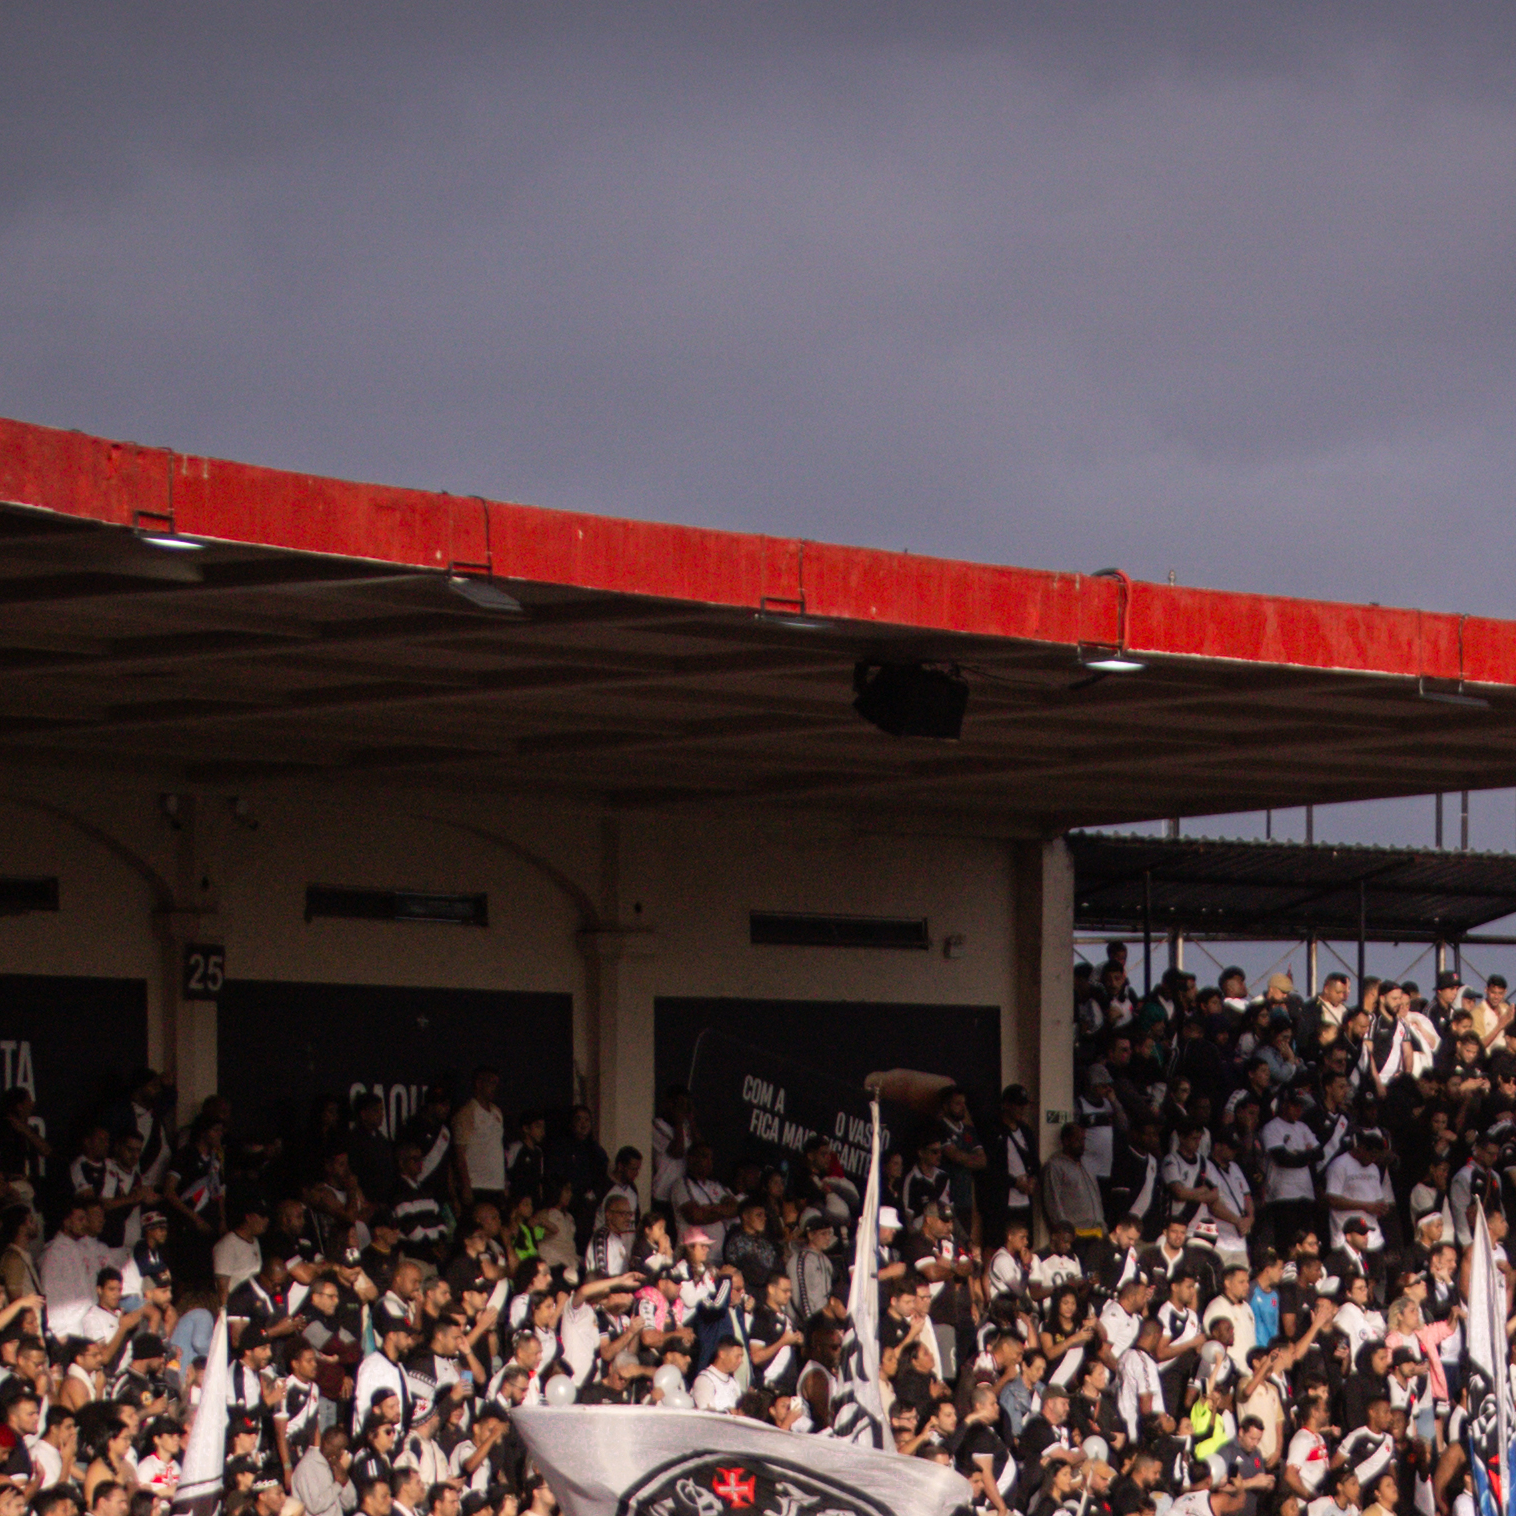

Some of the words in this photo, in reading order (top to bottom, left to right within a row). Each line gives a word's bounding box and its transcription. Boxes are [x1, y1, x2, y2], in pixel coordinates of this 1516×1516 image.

[187, 953, 224, 992] 25
[742, 1074, 774, 1109] COM
[774, 1087, 786, 1114] A
[835, 1111, 846, 1137] O
[848, 1114, 891, 1151] VASO
[749, 1108, 780, 1144] FICA
